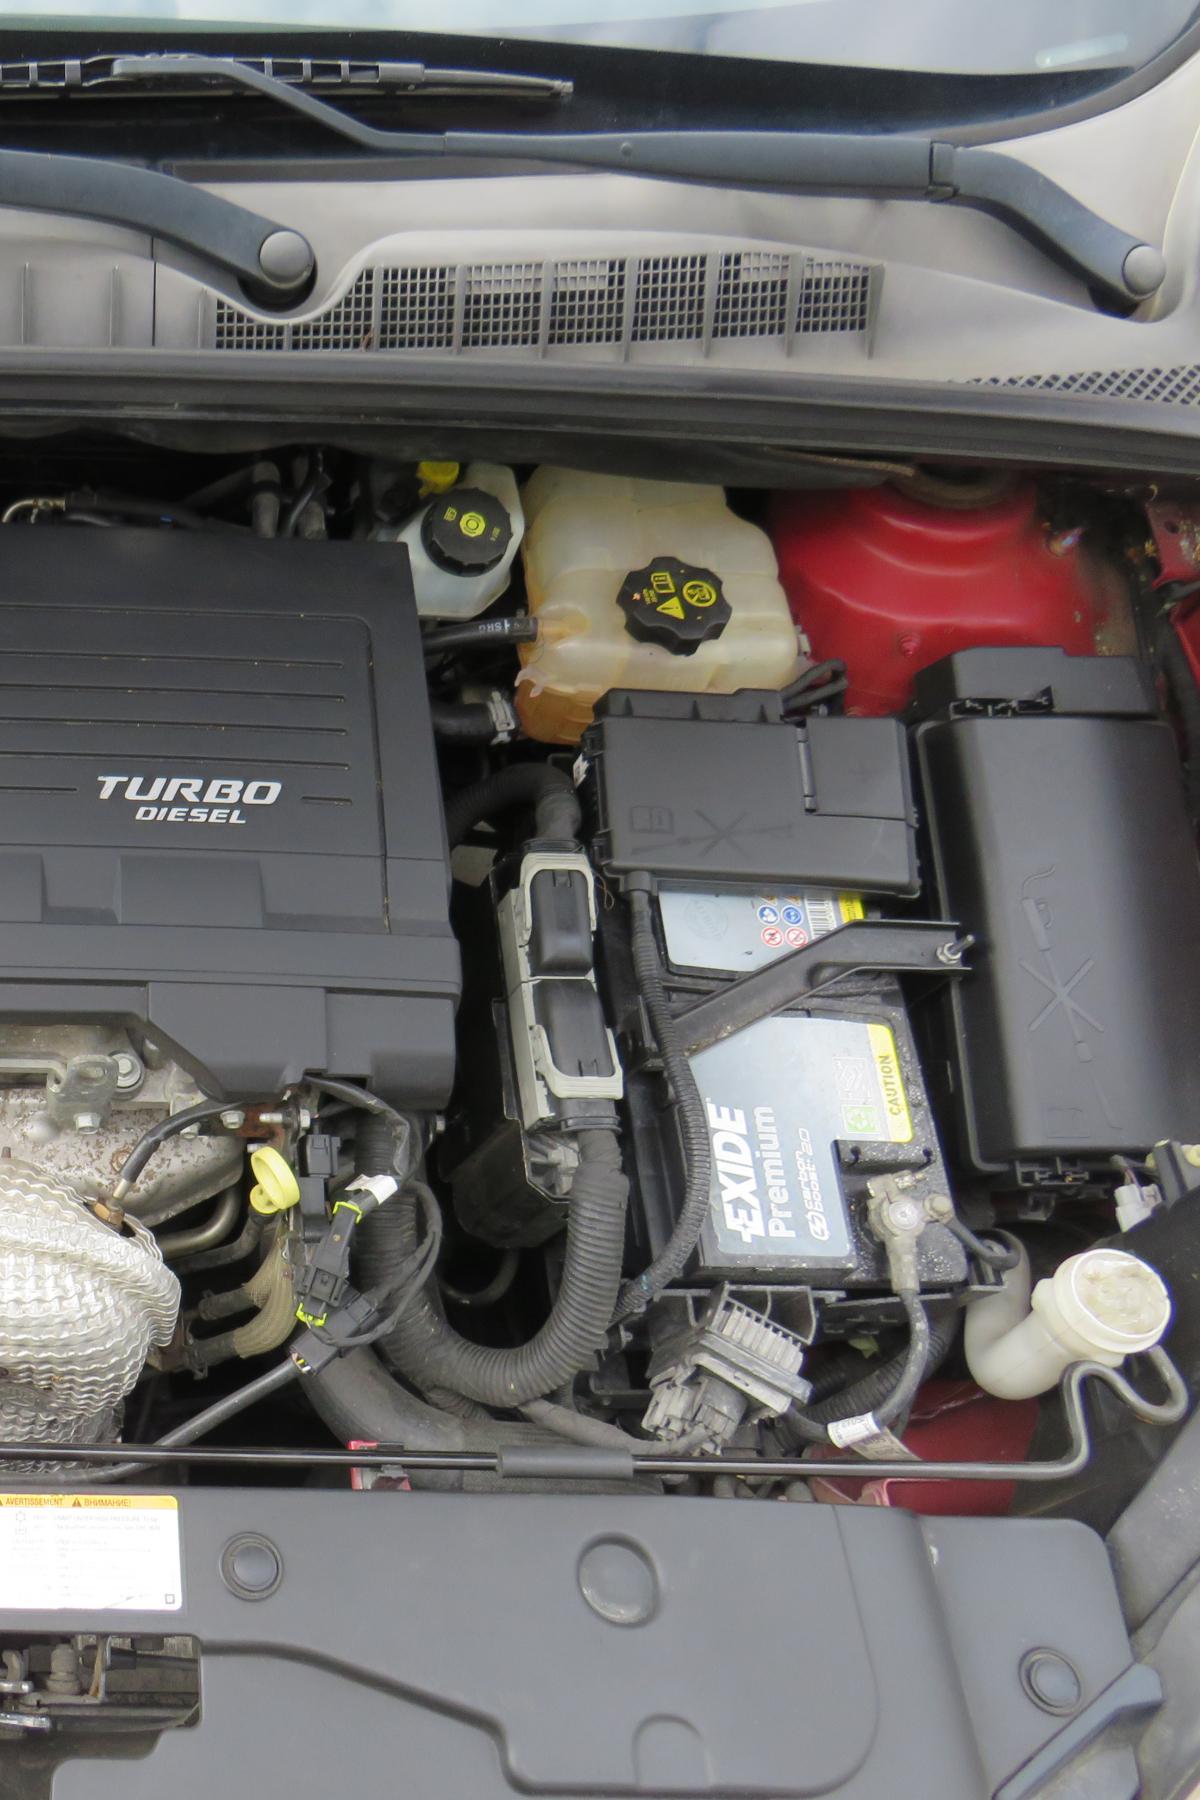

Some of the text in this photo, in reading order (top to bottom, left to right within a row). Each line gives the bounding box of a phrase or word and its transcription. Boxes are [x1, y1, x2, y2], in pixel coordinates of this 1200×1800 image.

[97, 775, 282, 805] TURBO
[135, 807, 247, 824] DIESEL
[878, 1055, 901, 1116] CAUTION
[706, 1103, 766, 1243] EXIDE
[753, 1106, 796, 1238] Premium
[796, 1150, 813, 1209] carbon
[5, 1497, 64, 1506] AVERTISSEMENT
